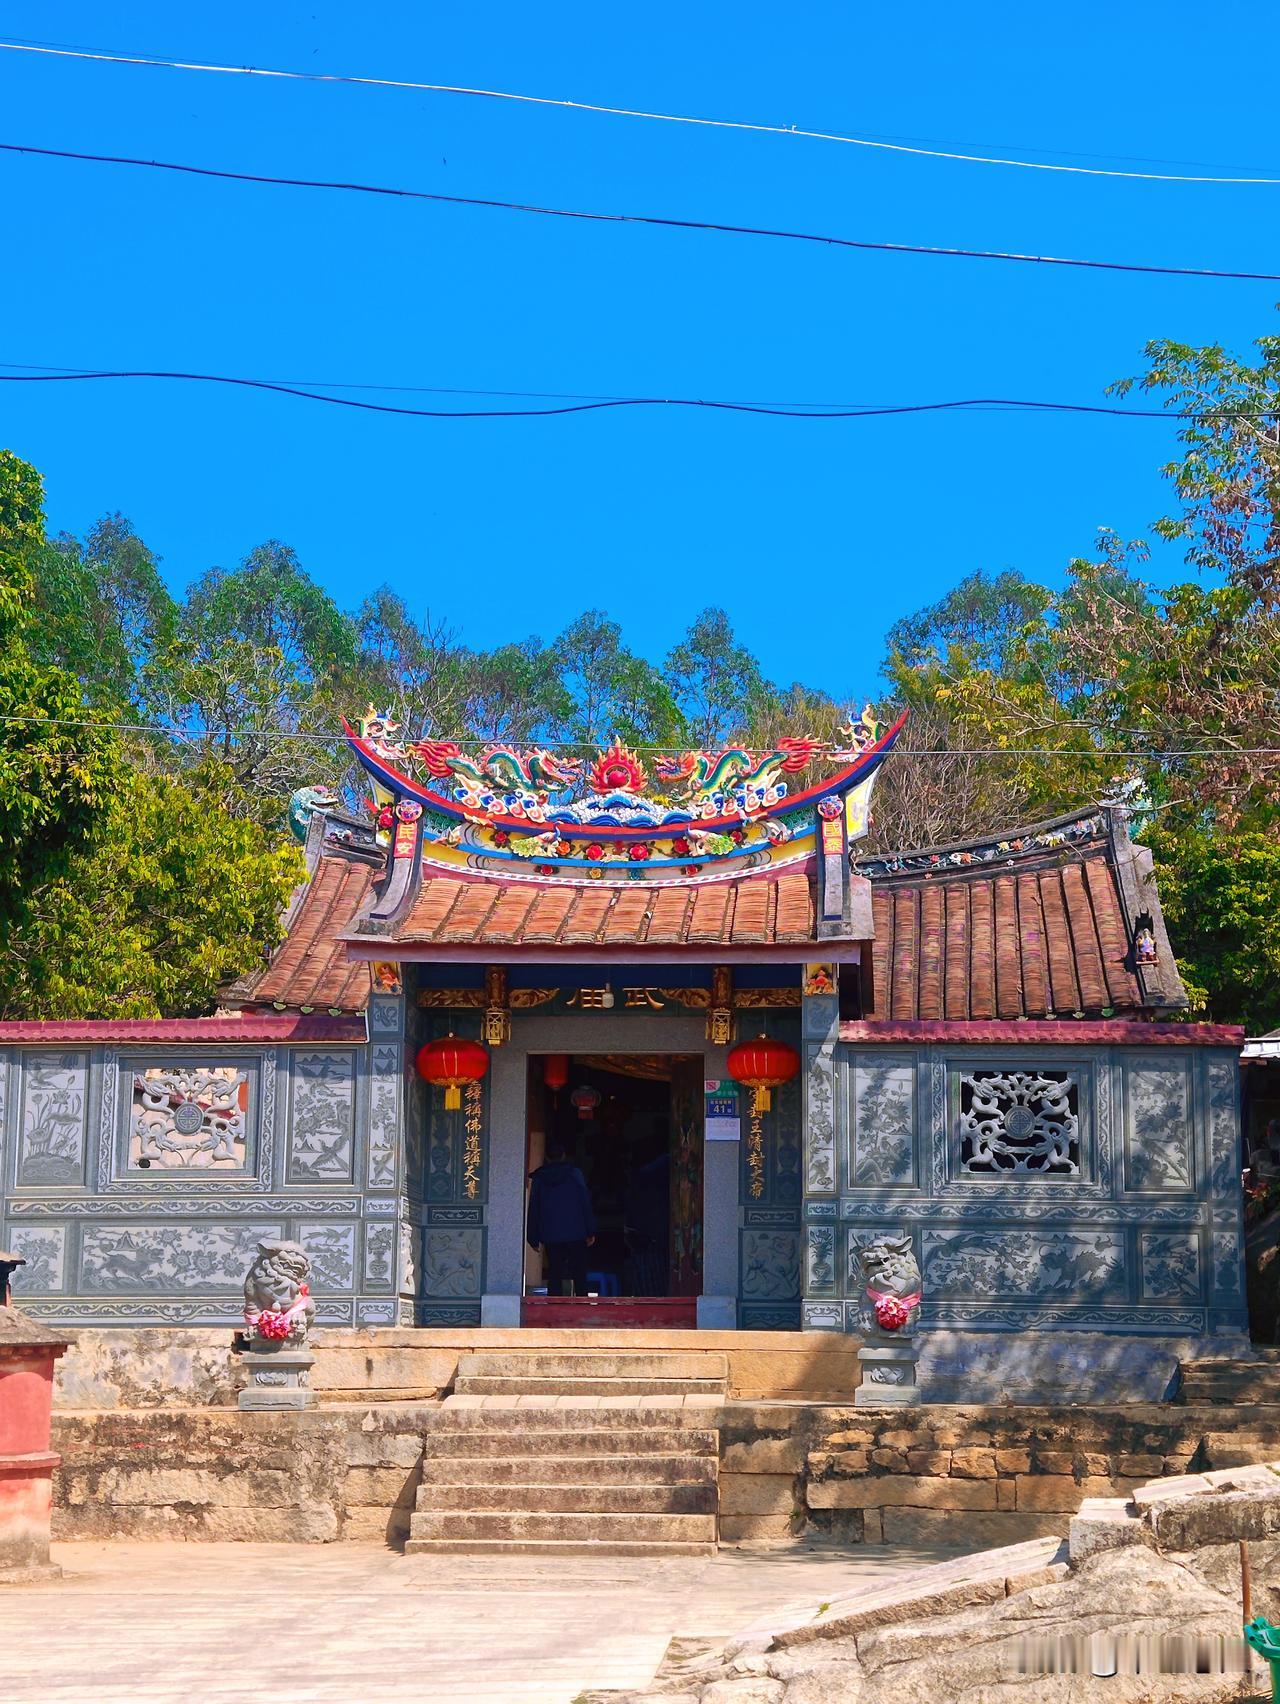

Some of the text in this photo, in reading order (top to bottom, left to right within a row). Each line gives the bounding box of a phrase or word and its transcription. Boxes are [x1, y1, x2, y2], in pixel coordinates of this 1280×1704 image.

[396, 824, 415, 855] 民安
[823, 821, 843, 851] 國泰
[463, 1079, 483, 1199] 釋稱佛道稱天尊
